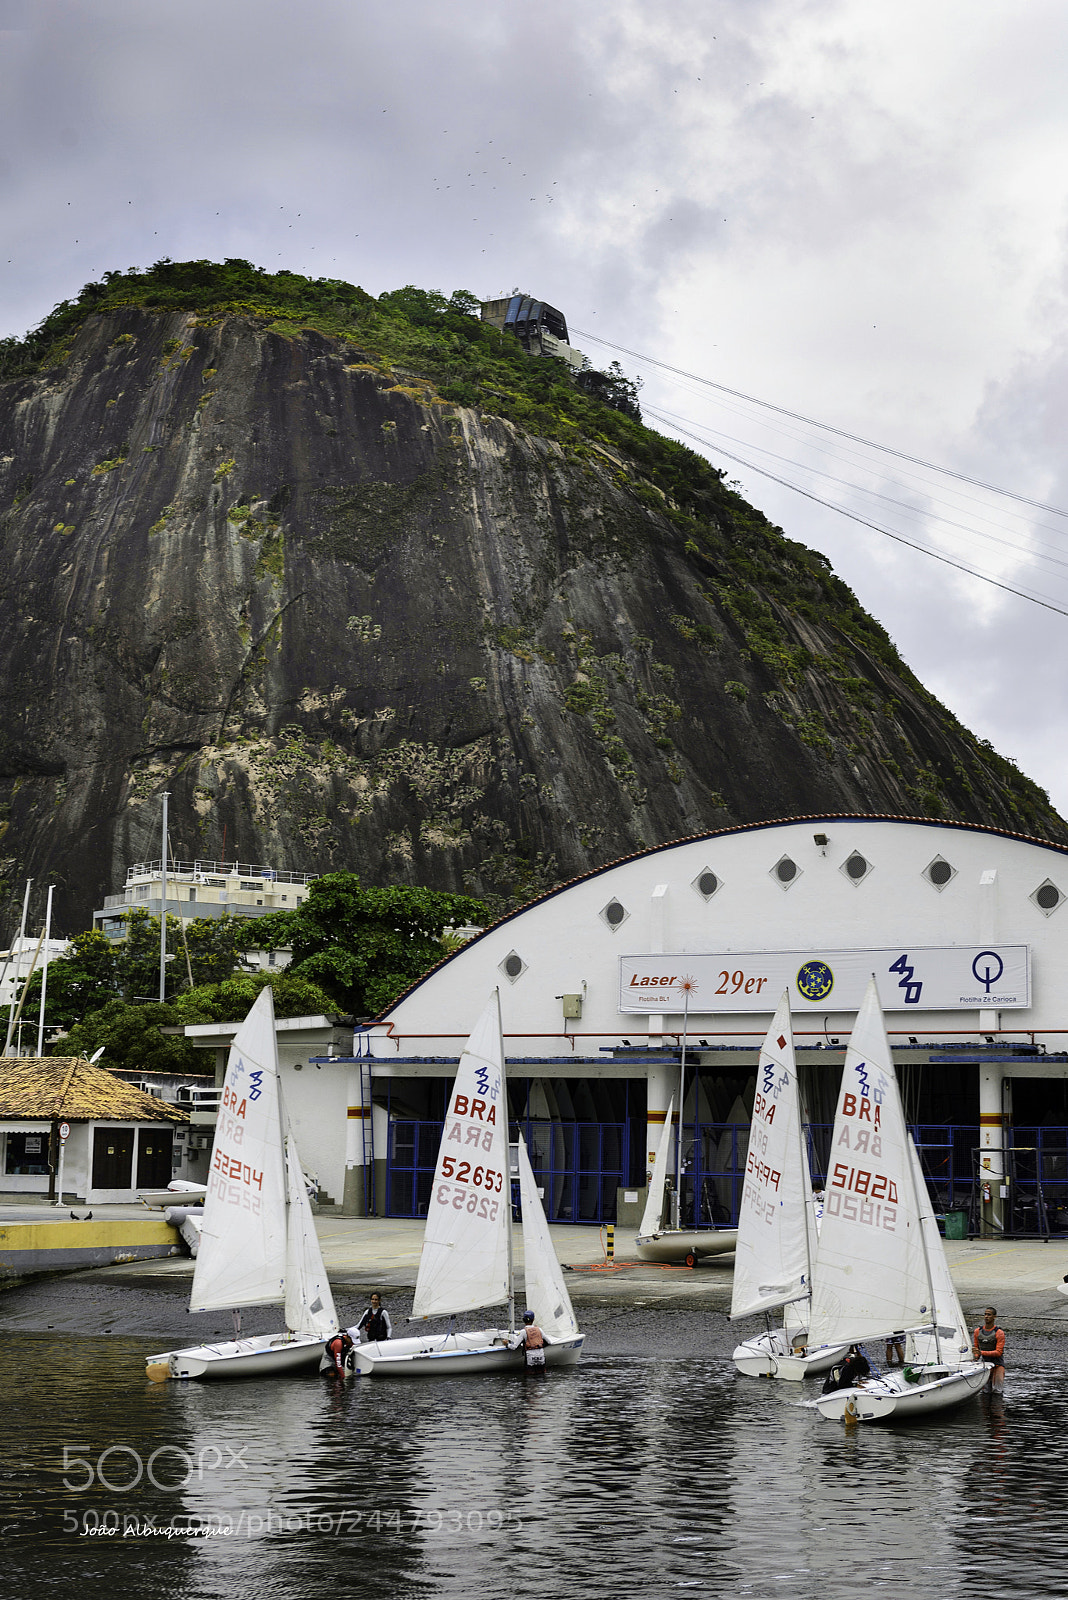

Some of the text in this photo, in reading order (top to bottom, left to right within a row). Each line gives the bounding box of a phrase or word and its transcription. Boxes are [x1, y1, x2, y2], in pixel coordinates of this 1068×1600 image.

[629, 974, 677, 986] Laser
[714, 970, 768, 994] 29er
[889, 954, 923, 1003] 420
[249, 1070, 264, 1101] 420
[474, 1066, 490, 1095] 420
[855, 1062, 870, 1097] 420
[223, 1085, 247, 1120] BRA
[453, 1094, 497, 1126] BRA
[755, 1092, 776, 1125] BRA
[842, 1092, 882, 1128] BRA
[213, 1148, 264, 1191] 52204
[441, 1156, 503, 1193] 52653
[831, 1163, 899, 1204] 51820
